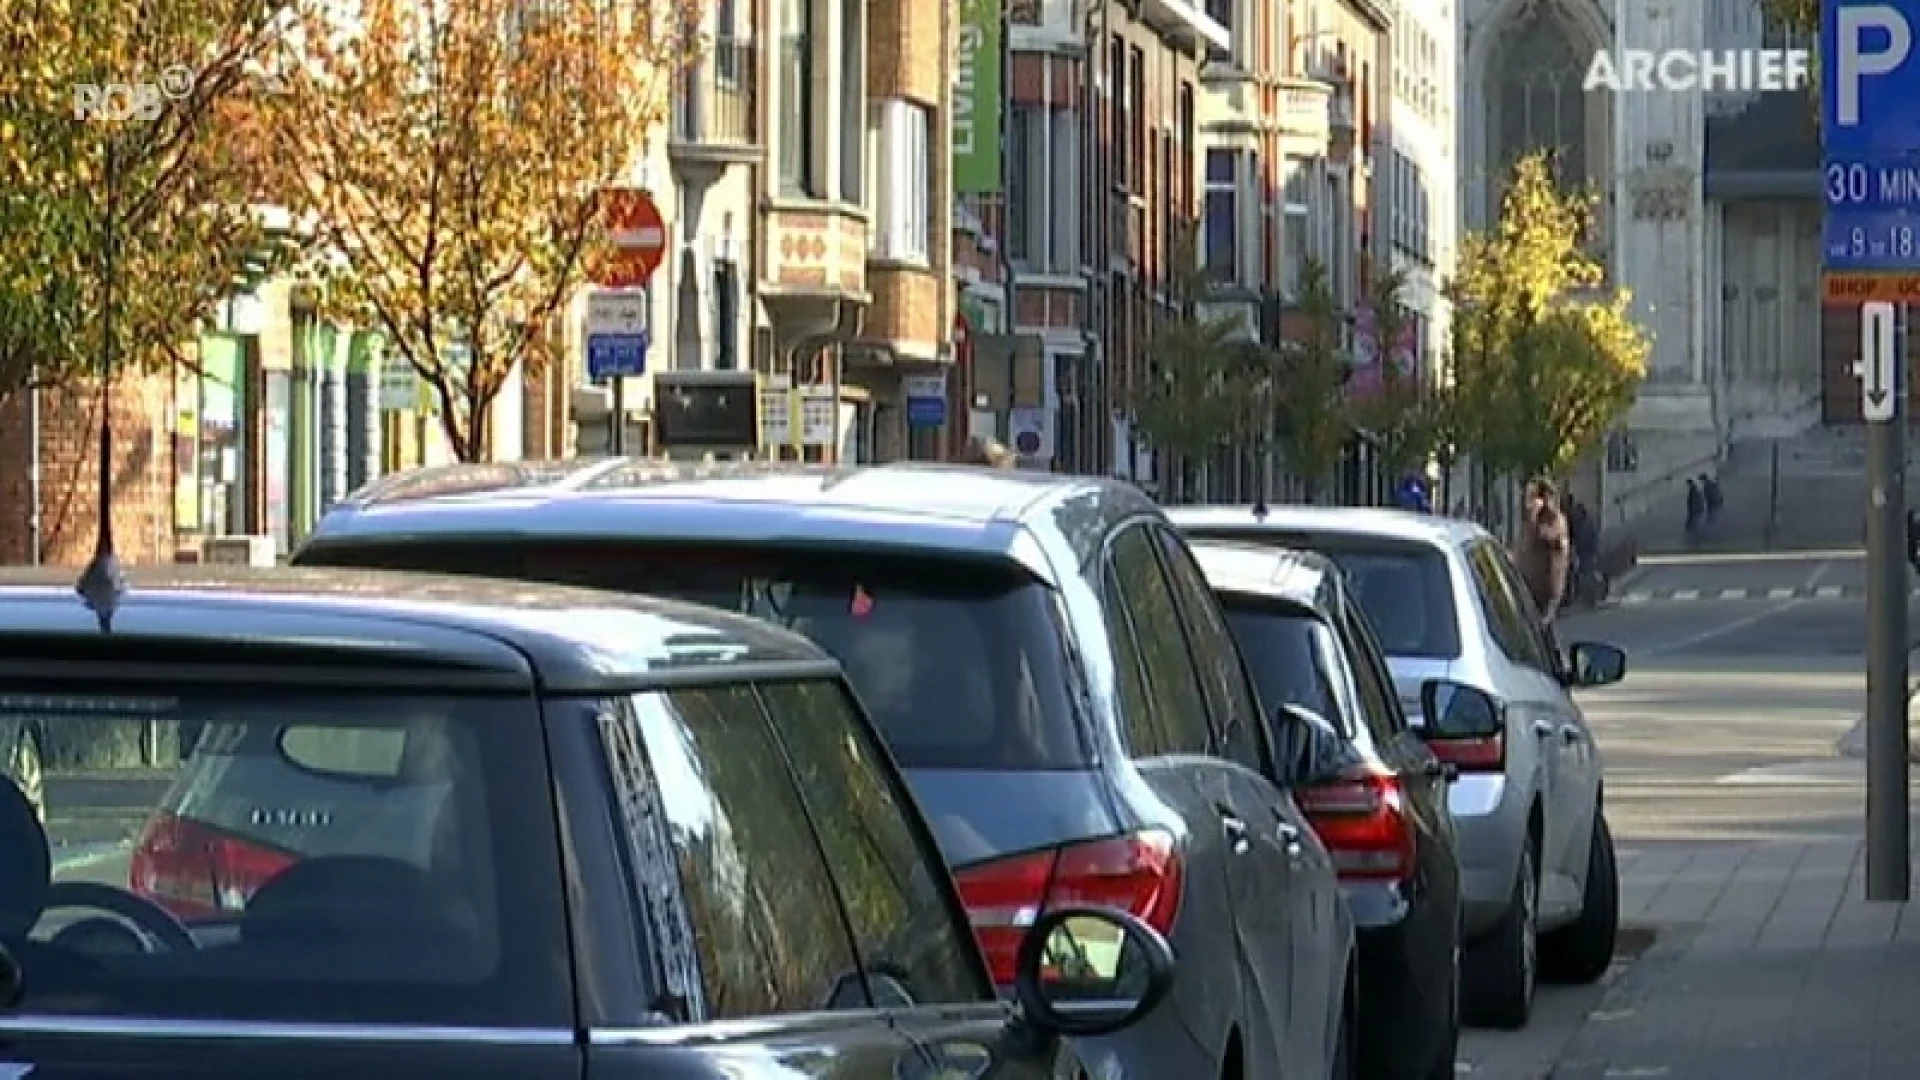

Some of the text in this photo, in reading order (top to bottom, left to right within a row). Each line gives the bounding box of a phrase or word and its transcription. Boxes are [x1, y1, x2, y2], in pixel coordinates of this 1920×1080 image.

[1836, 6, 1911, 126] P
[1828, 163, 1867, 204] 30
[1890, 226, 1911, 257] 18
